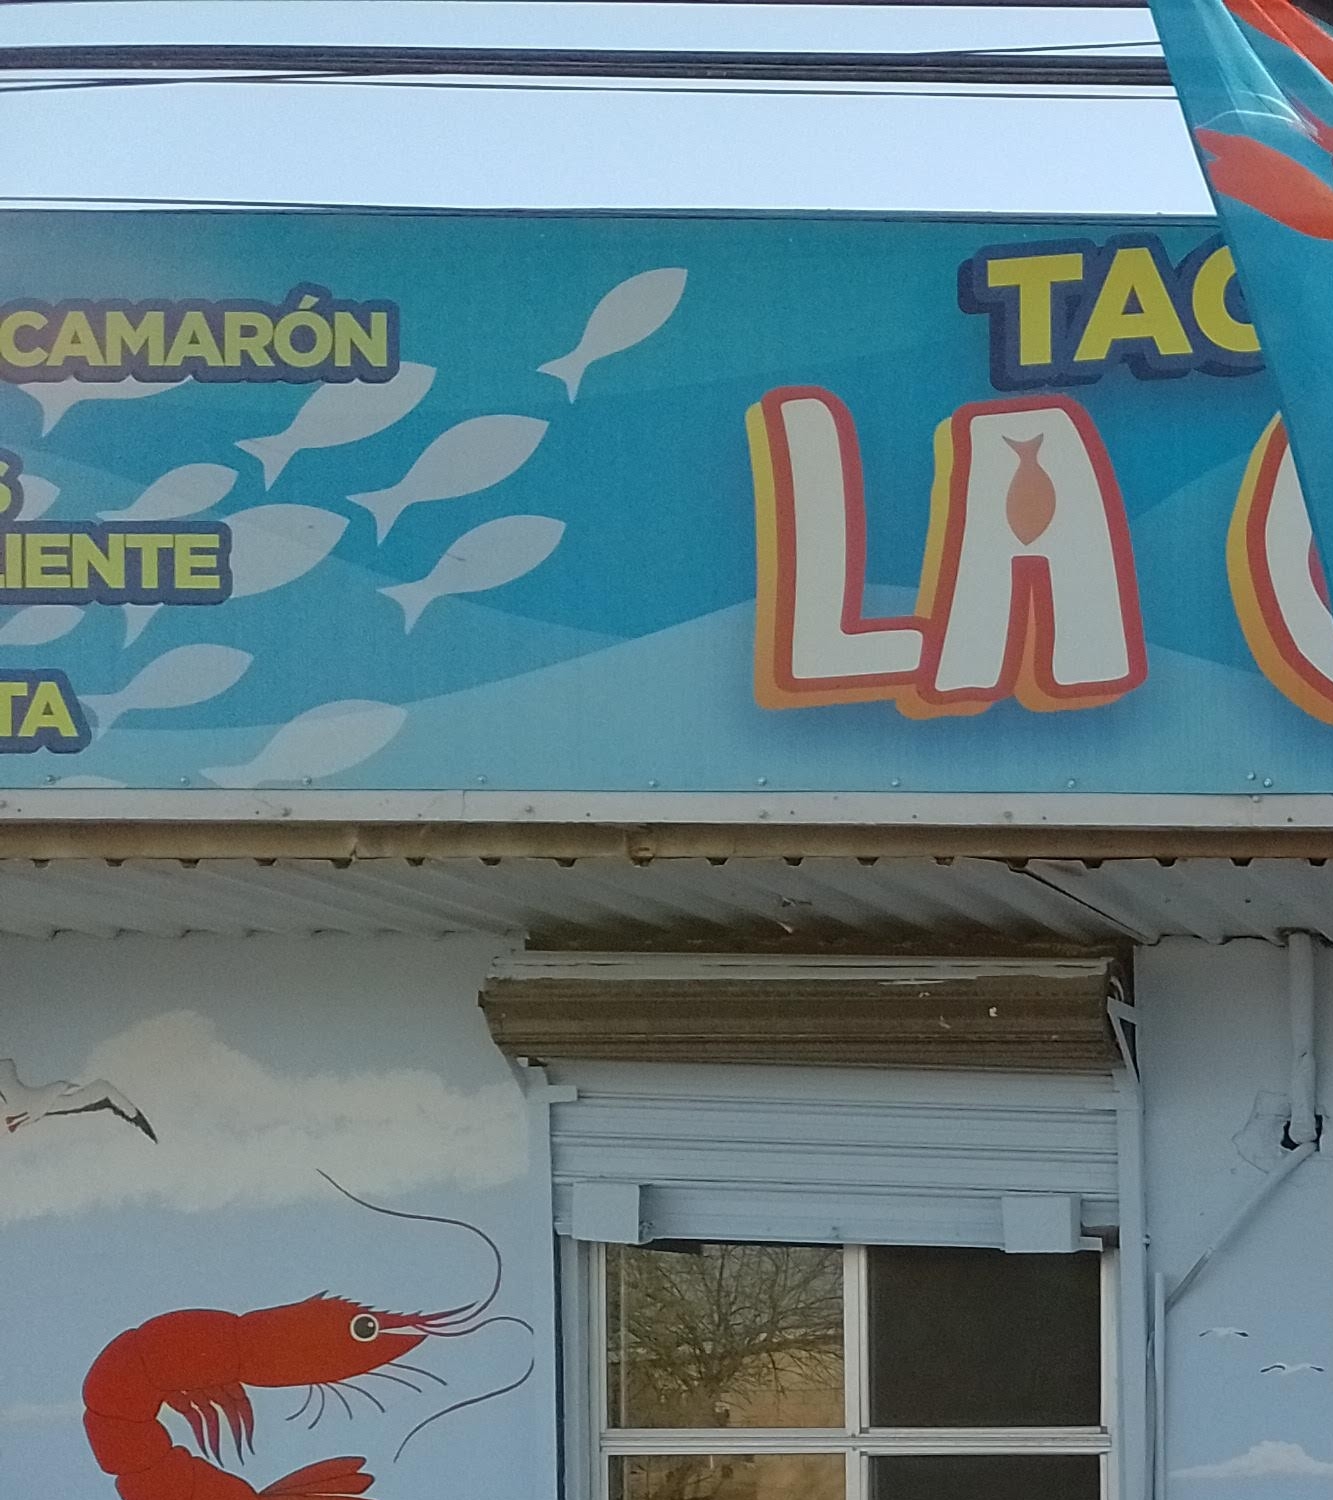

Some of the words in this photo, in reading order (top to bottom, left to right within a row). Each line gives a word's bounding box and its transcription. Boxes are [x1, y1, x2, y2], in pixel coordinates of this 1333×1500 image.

[1, 294, 388, 368] CAMARÓN
[986, 246, 1263, 367] TAC
[0, 532, 221, 589] IENTE
[765, 386, 1148, 703] LA
